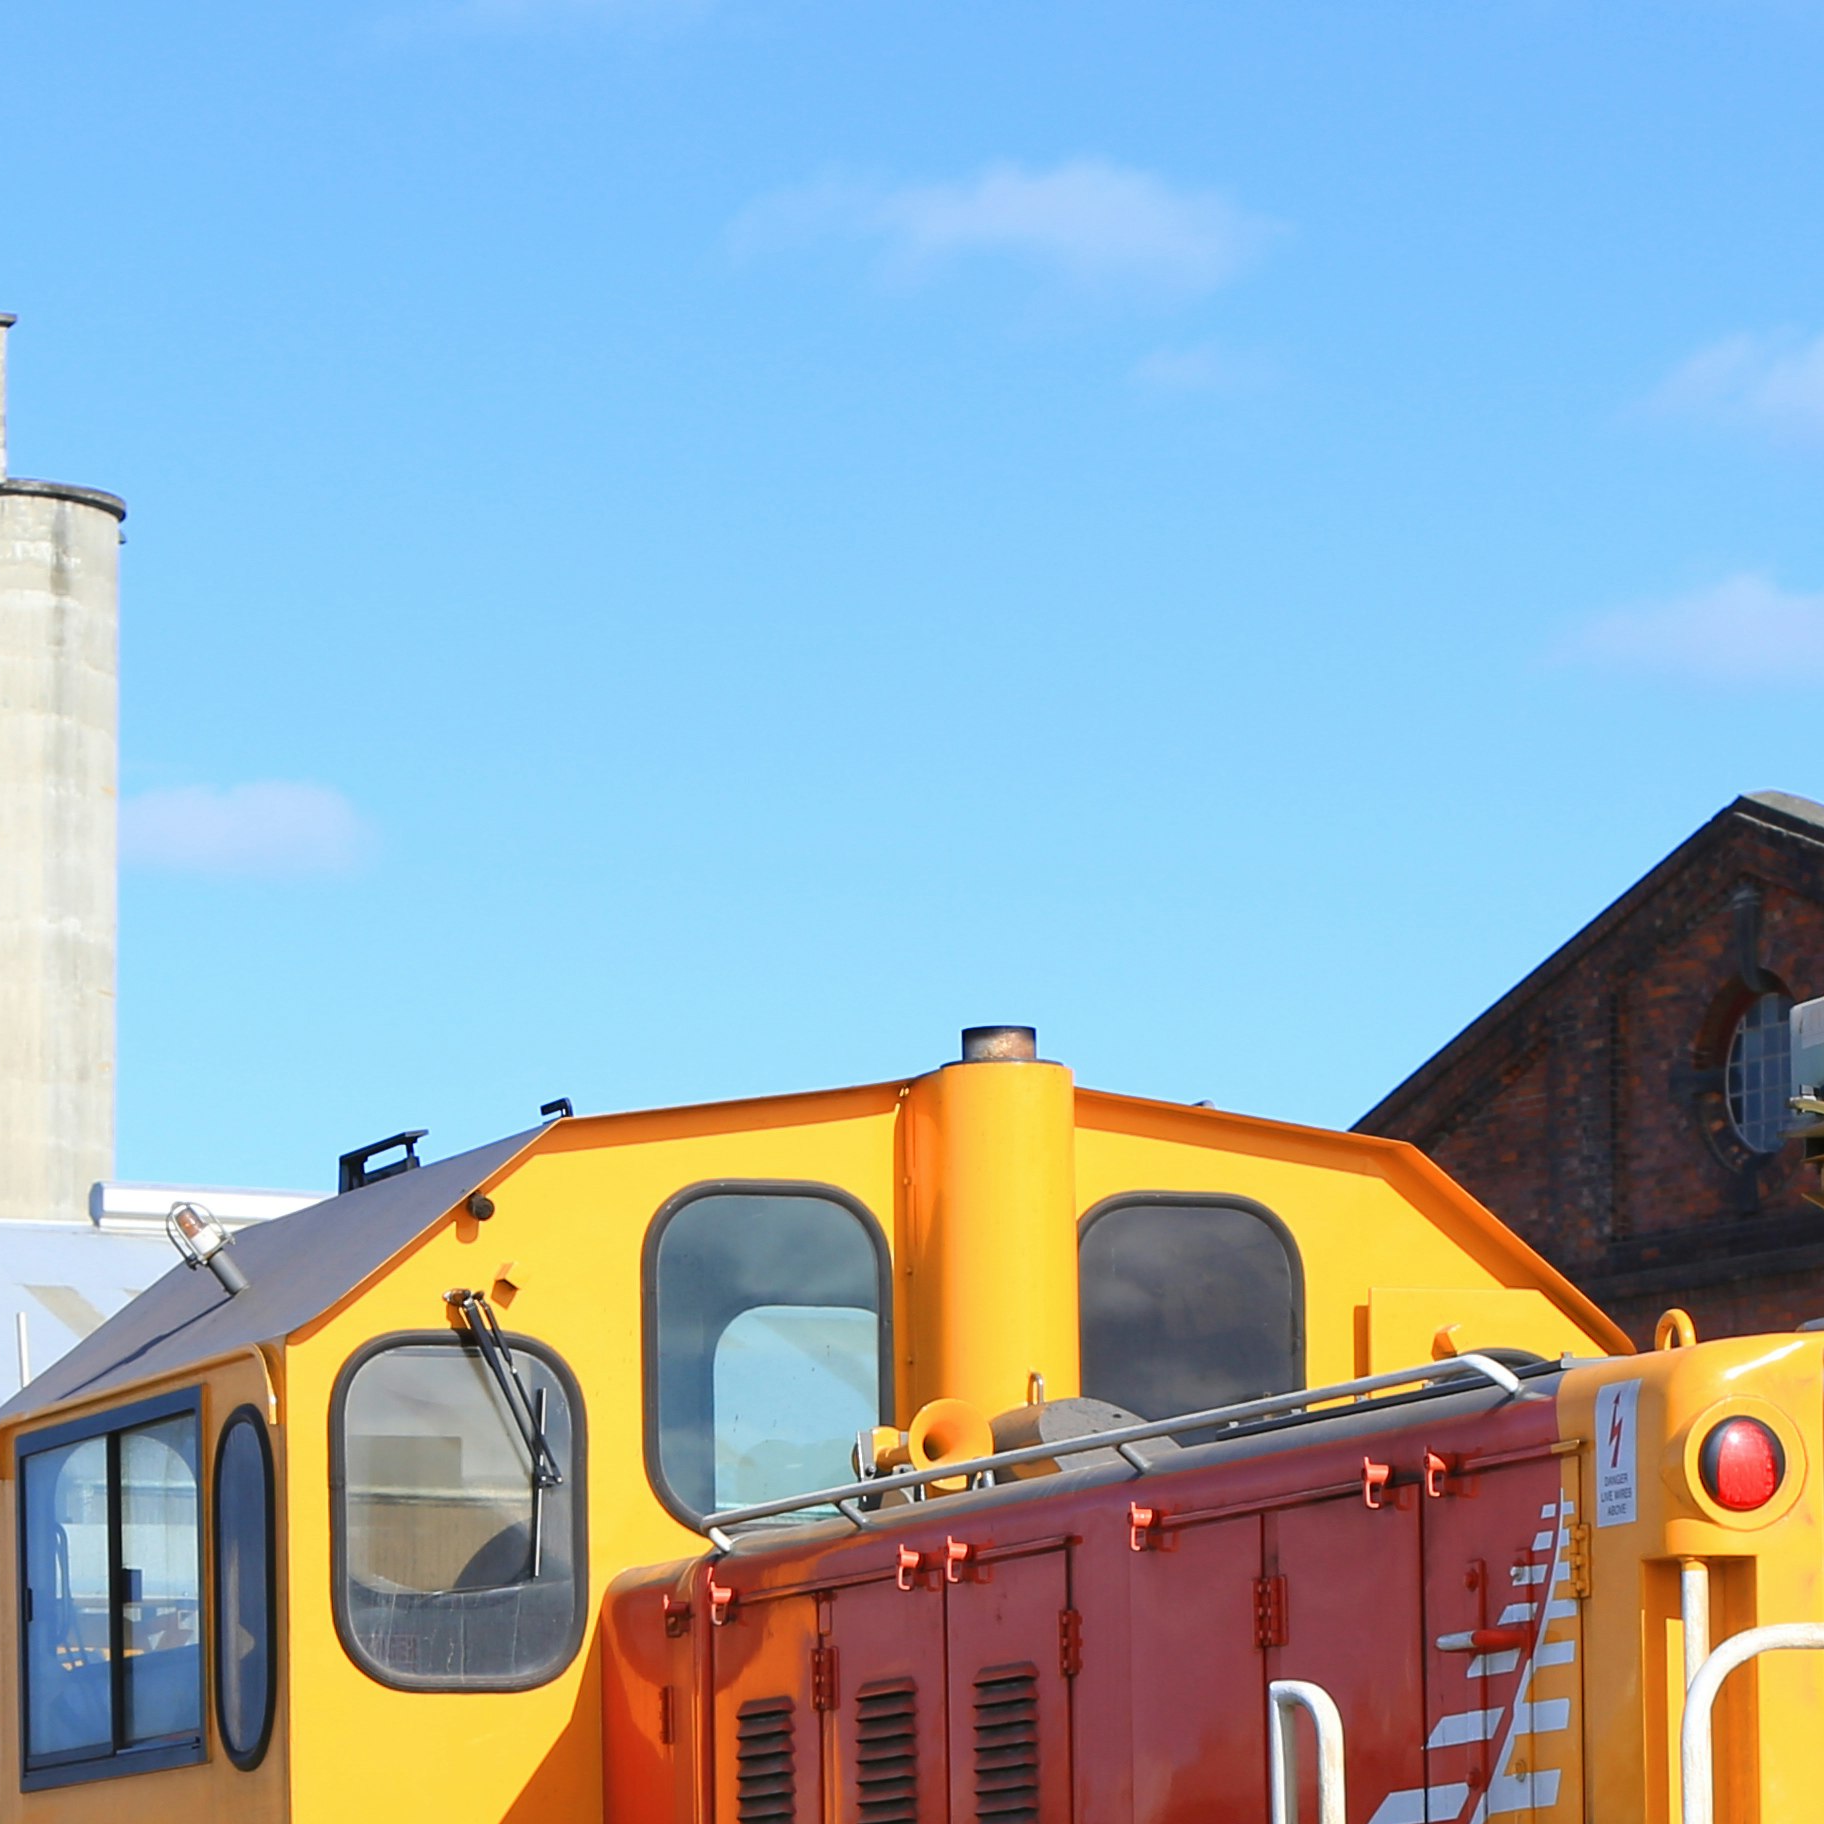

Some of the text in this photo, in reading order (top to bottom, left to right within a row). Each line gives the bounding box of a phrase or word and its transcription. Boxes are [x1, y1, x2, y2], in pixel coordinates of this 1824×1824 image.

[1604, 1473, 1628, 1487] DANGER
[1600, 1487, 1632, 1503] LIVE WIRES
[1607, 1503, 1627, 1517] ABOVE
